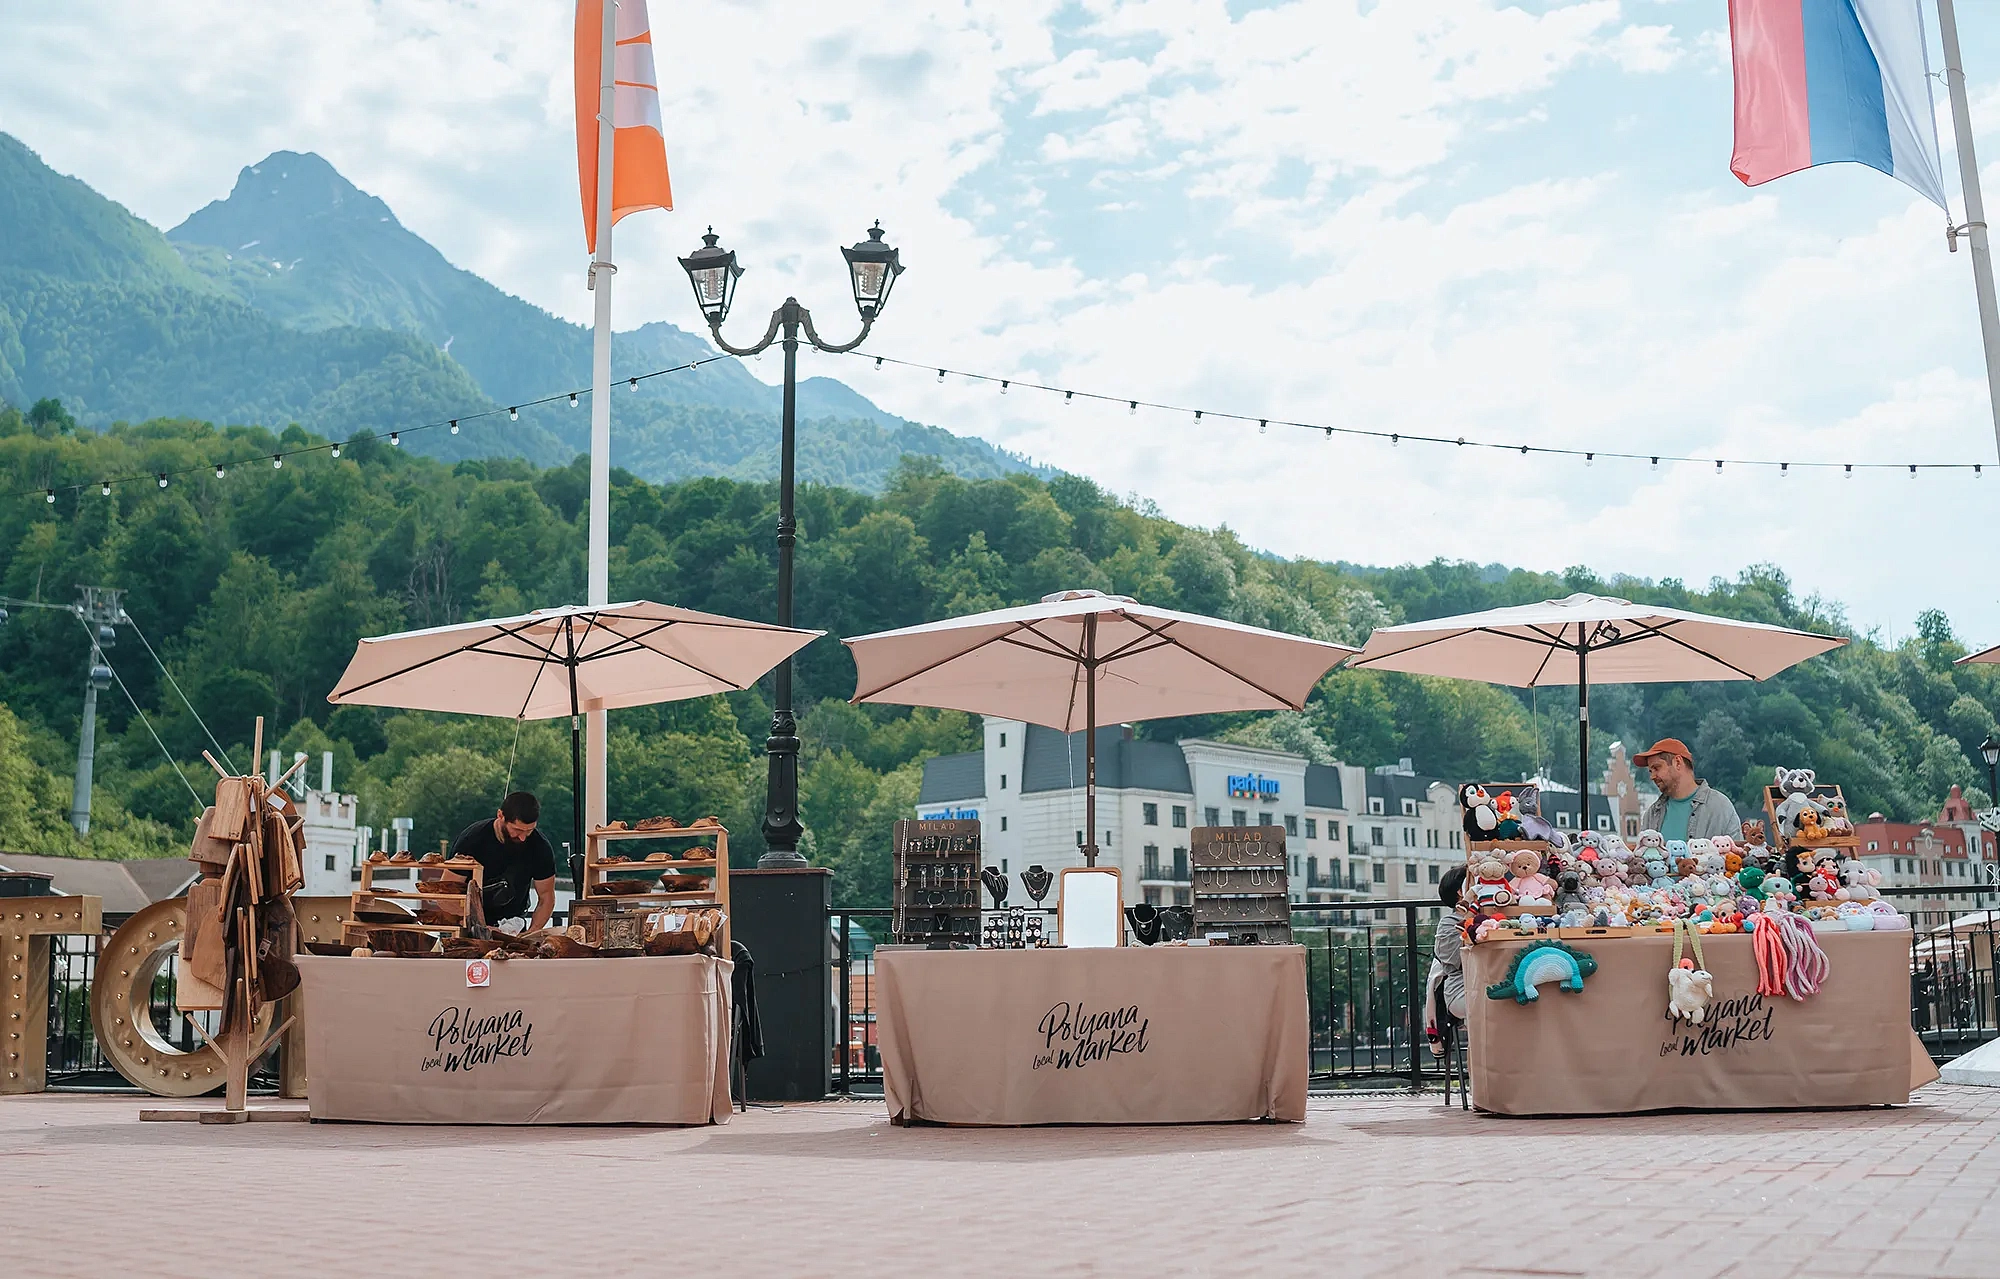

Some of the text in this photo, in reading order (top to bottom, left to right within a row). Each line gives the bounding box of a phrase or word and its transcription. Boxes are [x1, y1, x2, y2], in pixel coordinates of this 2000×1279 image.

[1227, 772, 1280, 797] park inn
[919, 822, 956, 832] MILAD
[1215, 831, 1263, 842] MILAD
[428, 1006, 523, 1051] Polyana
[1038, 1001, 1139, 1049] Polyana
[1664, 991, 1764, 1035] yana
